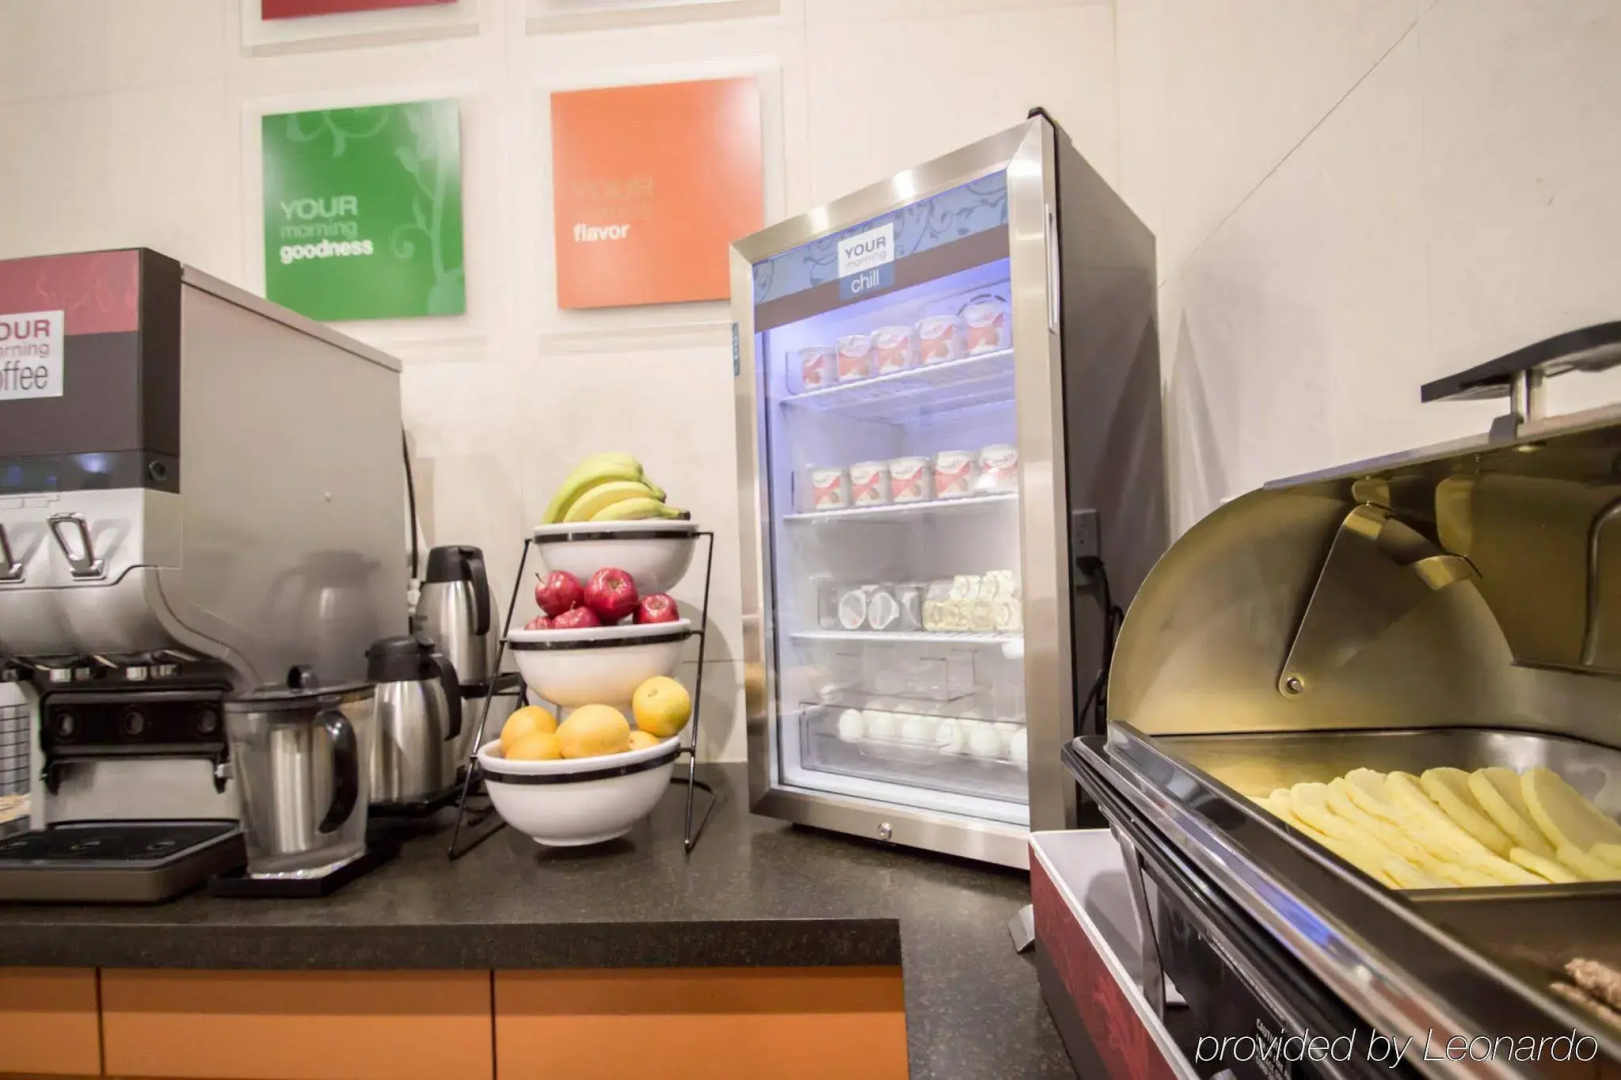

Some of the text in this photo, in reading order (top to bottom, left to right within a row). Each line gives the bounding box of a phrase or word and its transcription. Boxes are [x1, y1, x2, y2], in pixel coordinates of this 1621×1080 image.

[280, 195, 358, 220] YOUR
[281, 221, 358, 240] morning
[573, 223, 631, 242] flavor
[280, 239, 373, 264] goodness
[844, 235, 887, 259] YOUR
[844, 250, 887, 272] morning
[851, 268, 880, 293] chill
[0, 343, 50, 358] rning
[0, 360, 48, 391] ffee
